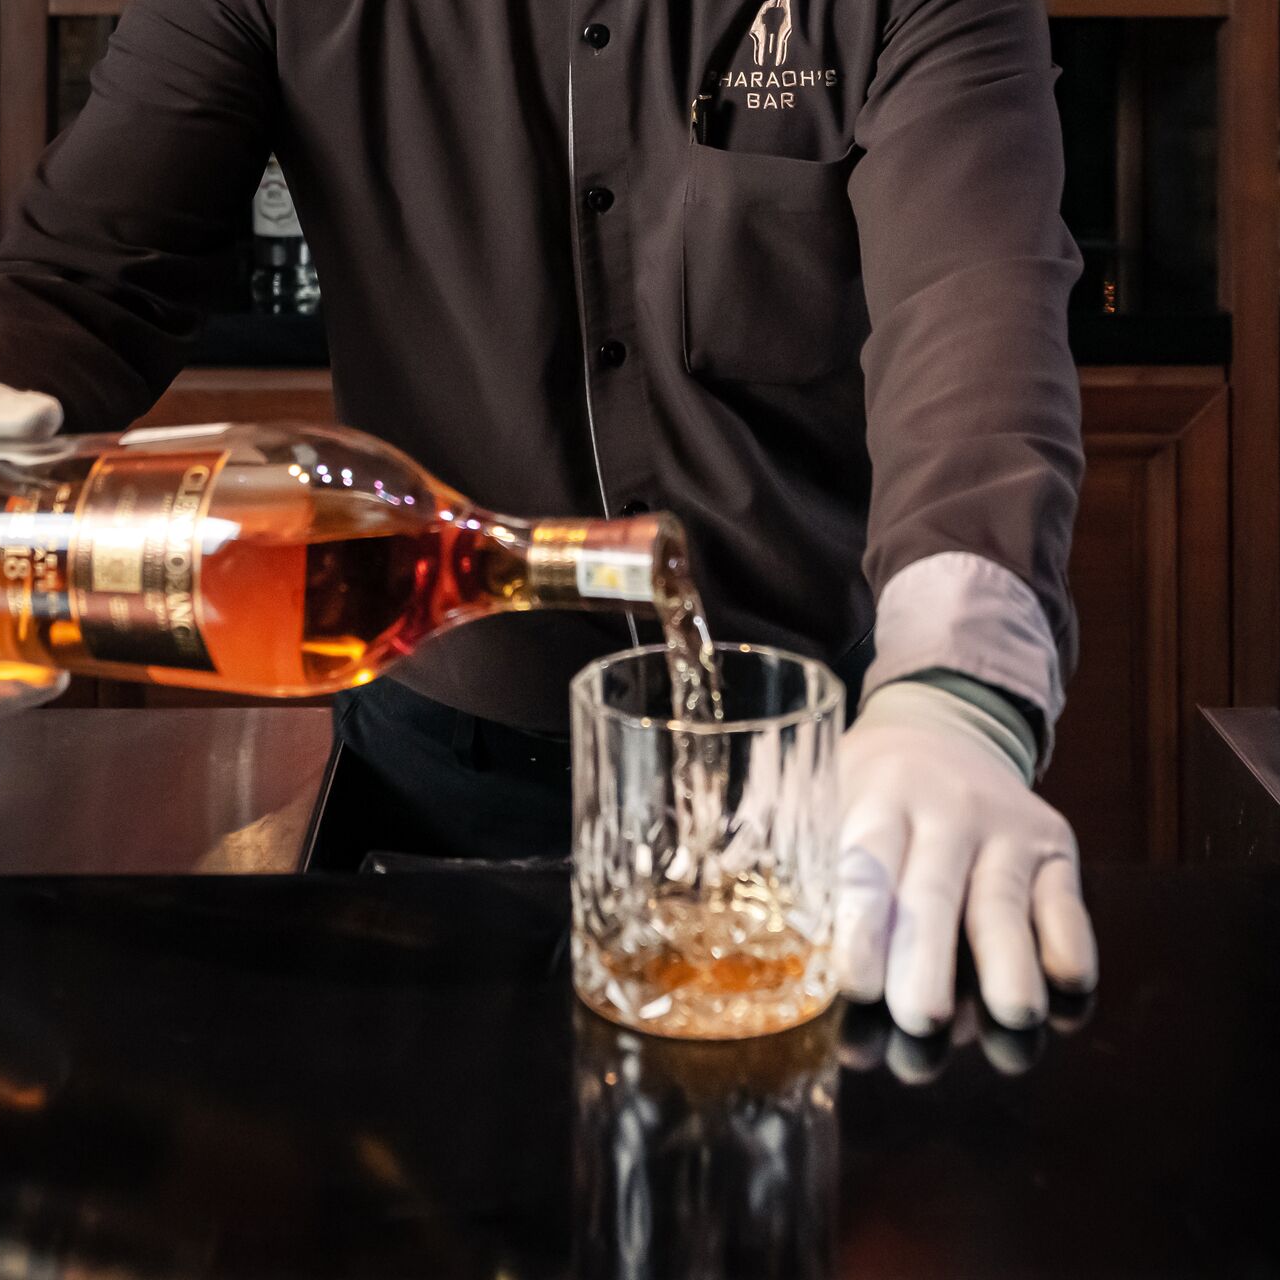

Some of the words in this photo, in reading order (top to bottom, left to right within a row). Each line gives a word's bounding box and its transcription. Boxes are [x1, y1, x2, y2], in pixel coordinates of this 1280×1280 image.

[708, 70, 838, 88] HARAOH'S
[746, 92, 796, 110] BAR
[3, 546, 32, 581] 18
